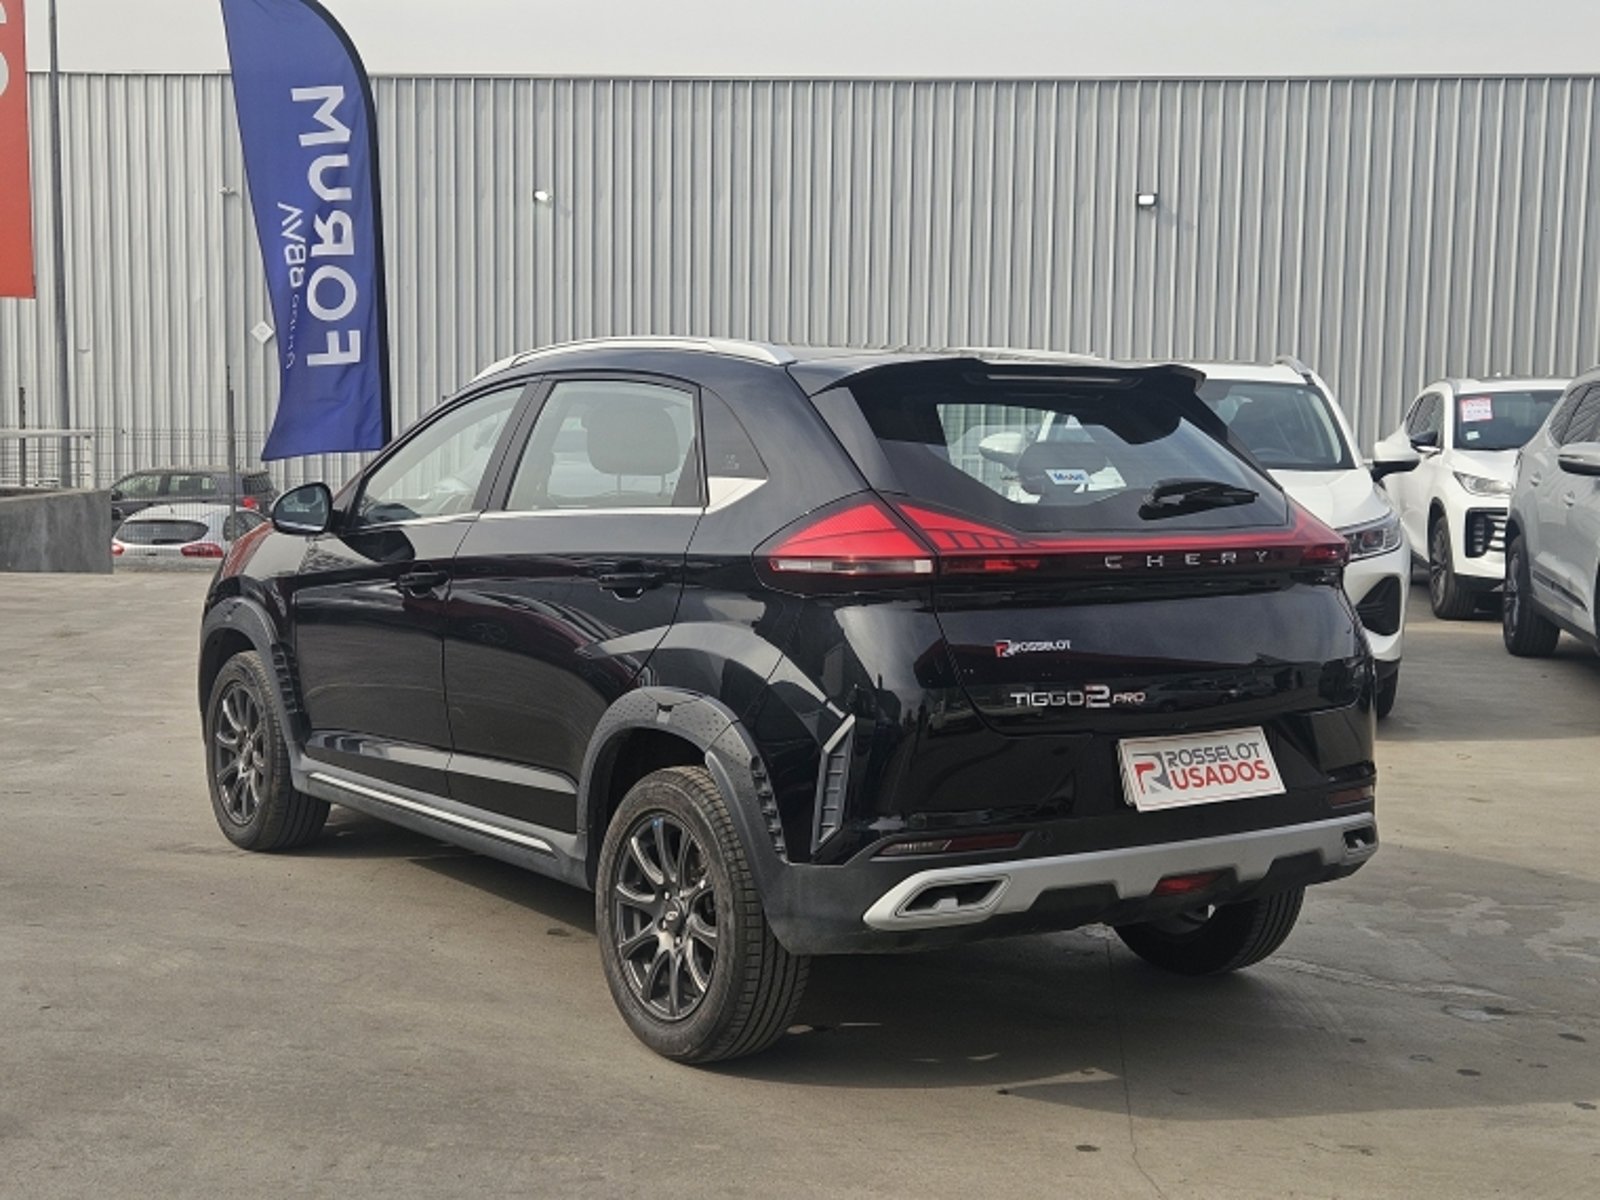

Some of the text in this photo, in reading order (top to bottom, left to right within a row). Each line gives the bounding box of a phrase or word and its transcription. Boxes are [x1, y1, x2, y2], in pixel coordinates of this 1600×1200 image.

[1104, 551, 1268, 569] CHERY
[1010, 690, 1084, 707] TIGGO
[1112, 691, 1146, 705] PRO
[1164, 742, 1259, 768] ROSSELOT
[1170, 759, 1270, 790] USADOS
